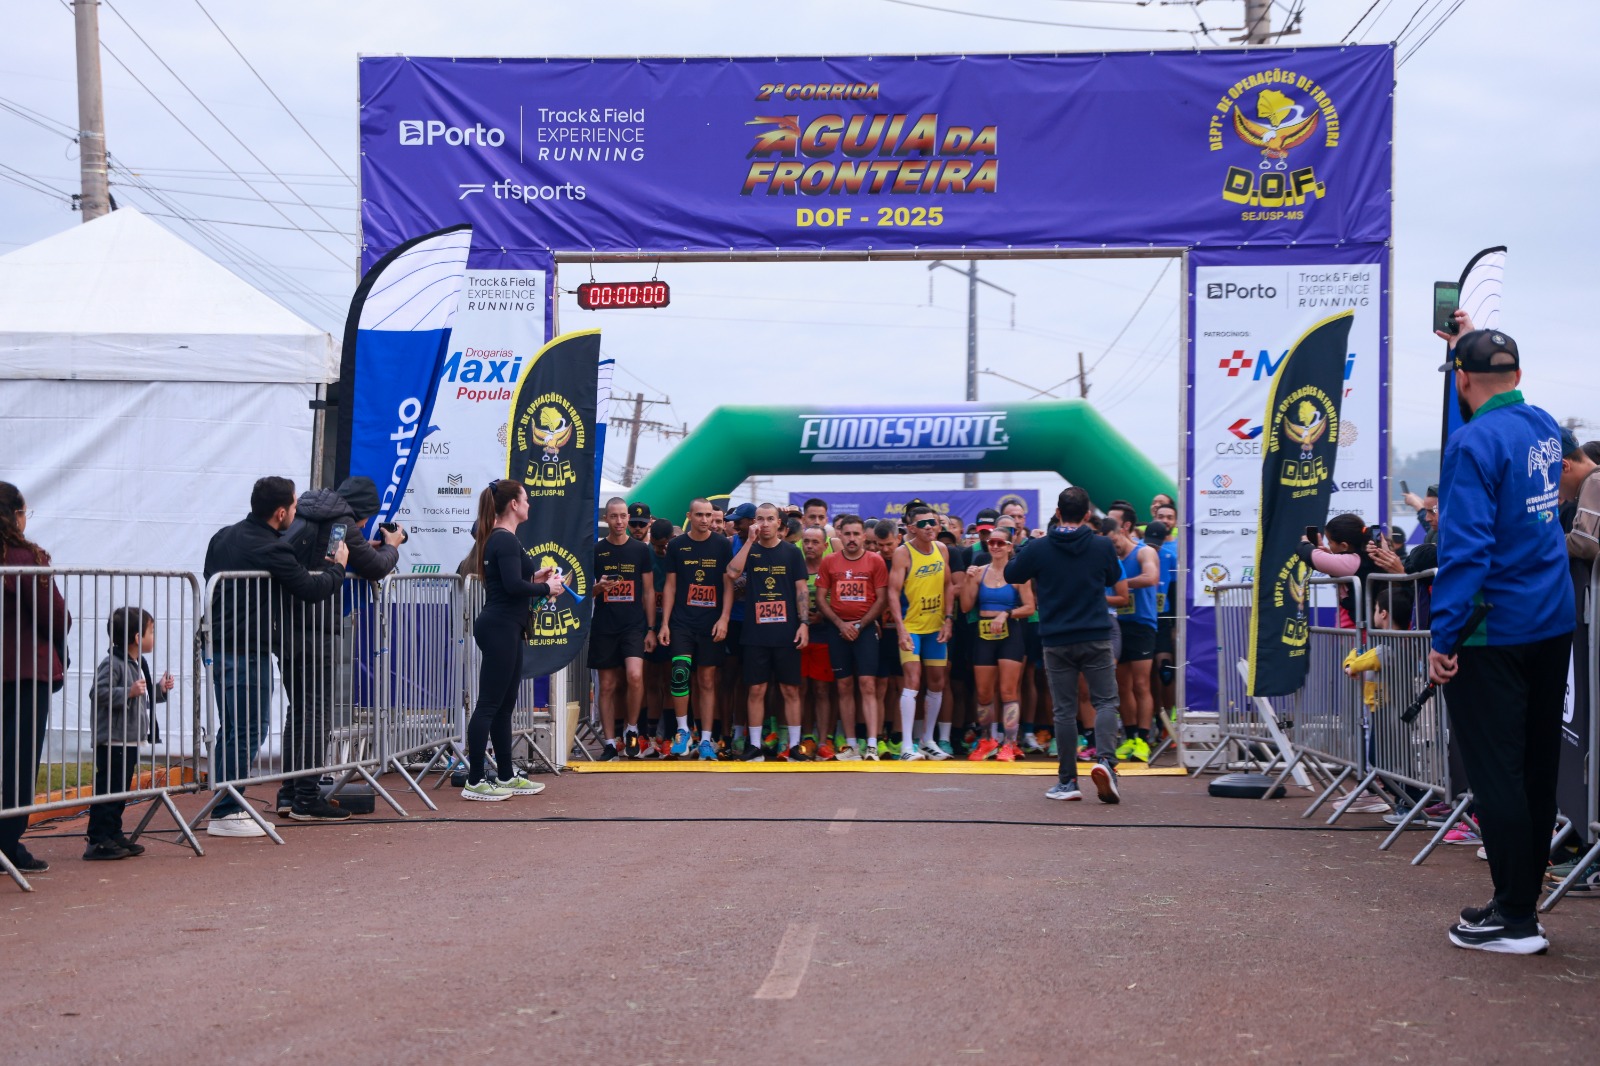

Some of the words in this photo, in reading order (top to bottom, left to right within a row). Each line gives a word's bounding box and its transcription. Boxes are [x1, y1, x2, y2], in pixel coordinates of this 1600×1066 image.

[784, 82, 879, 101] CORRIDA
[1216, 96, 1233, 114] DE
[1228, 68, 1296, 100] OPERAÇÕES
[1296, 75, 1314, 92] DE
[1309, 85, 1340, 147] FRONTEIRA
[538, 108, 587, 123] Track
[604, 108, 645, 123] Field
[427, 120, 505, 148] Porto
[538, 128, 645, 143] EXPERIENCE
[938, 125, 998, 157] DA
[538, 147, 645, 162] RUNNING
[740, 159, 999, 197] FRONTEIRA
[492, 179, 586, 204] tfsports
[796, 207, 852, 227] DOF
[877, 206, 944, 227] 2025
[1241, 211, 1304, 221] SEJUSP-MS
[468, 277, 499, 287] Track
[509, 277, 536, 287] Field
[468, 289, 535, 300] EXPERIENCE
[590, 286, 664, 305] 00:00:00
[1225, 283, 1277, 299] Porto
[1298, 284, 1370, 296] EXPERIENCE
[468, 302, 535, 312] RUNNING
[1299, 297, 1370, 308] RUNNING
[465, 348, 513, 360] Drogarias
[800, 415, 1007, 449] FUNDESPORTE
[418, 442, 450, 455] EMS
[1216, 442, 1263, 455] CASSE
[1341, 479, 1374, 490] cerdil
[1218, 508, 1241, 516] Porto
[566, 554, 586, 595] FRONTEIRA
[607, 583, 632, 597] 2522
[692, 587, 715, 601] 2510
[840, 583, 865, 597] 2384
[759, 604, 784, 617] 2542
[982, 622, 1006, 634] 112
[529, 638, 568, 646] SEJUSP-MS
